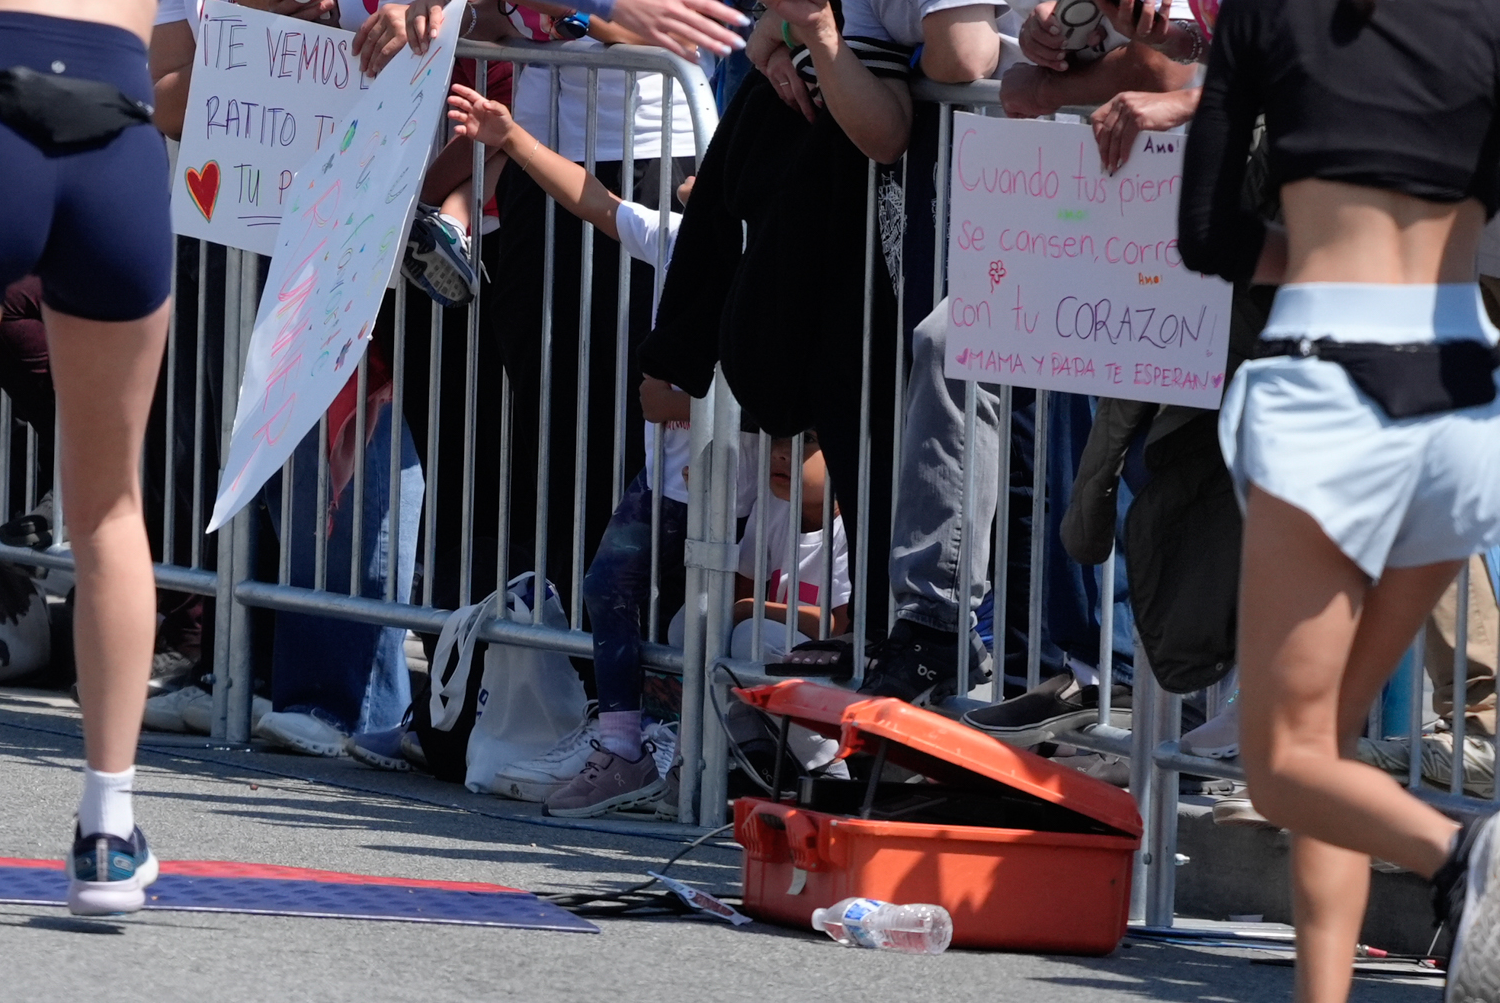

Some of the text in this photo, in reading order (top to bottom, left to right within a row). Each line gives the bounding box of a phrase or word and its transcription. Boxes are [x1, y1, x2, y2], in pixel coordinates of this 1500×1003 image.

[266, 27, 349, 89] VEMOS
[206, 96, 296, 147] RATITO
[233, 163, 260, 207] TU
[958, 129, 1060, 199] Cuando
[1072, 141, 1107, 204] tus
[1000, 228, 1099, 263] cansen,
[951, 297, 991, 329] con
[1012, 285, 1040, 333] tu
[231, 178, 340, 492] RUNNER
[969, 350, 1027, 374] MAMA
[1031, 355, 1045, 373] Y
[1104, 362, 1123, 385] TE
[1134, 363, 1210, 390] ESPERAN
